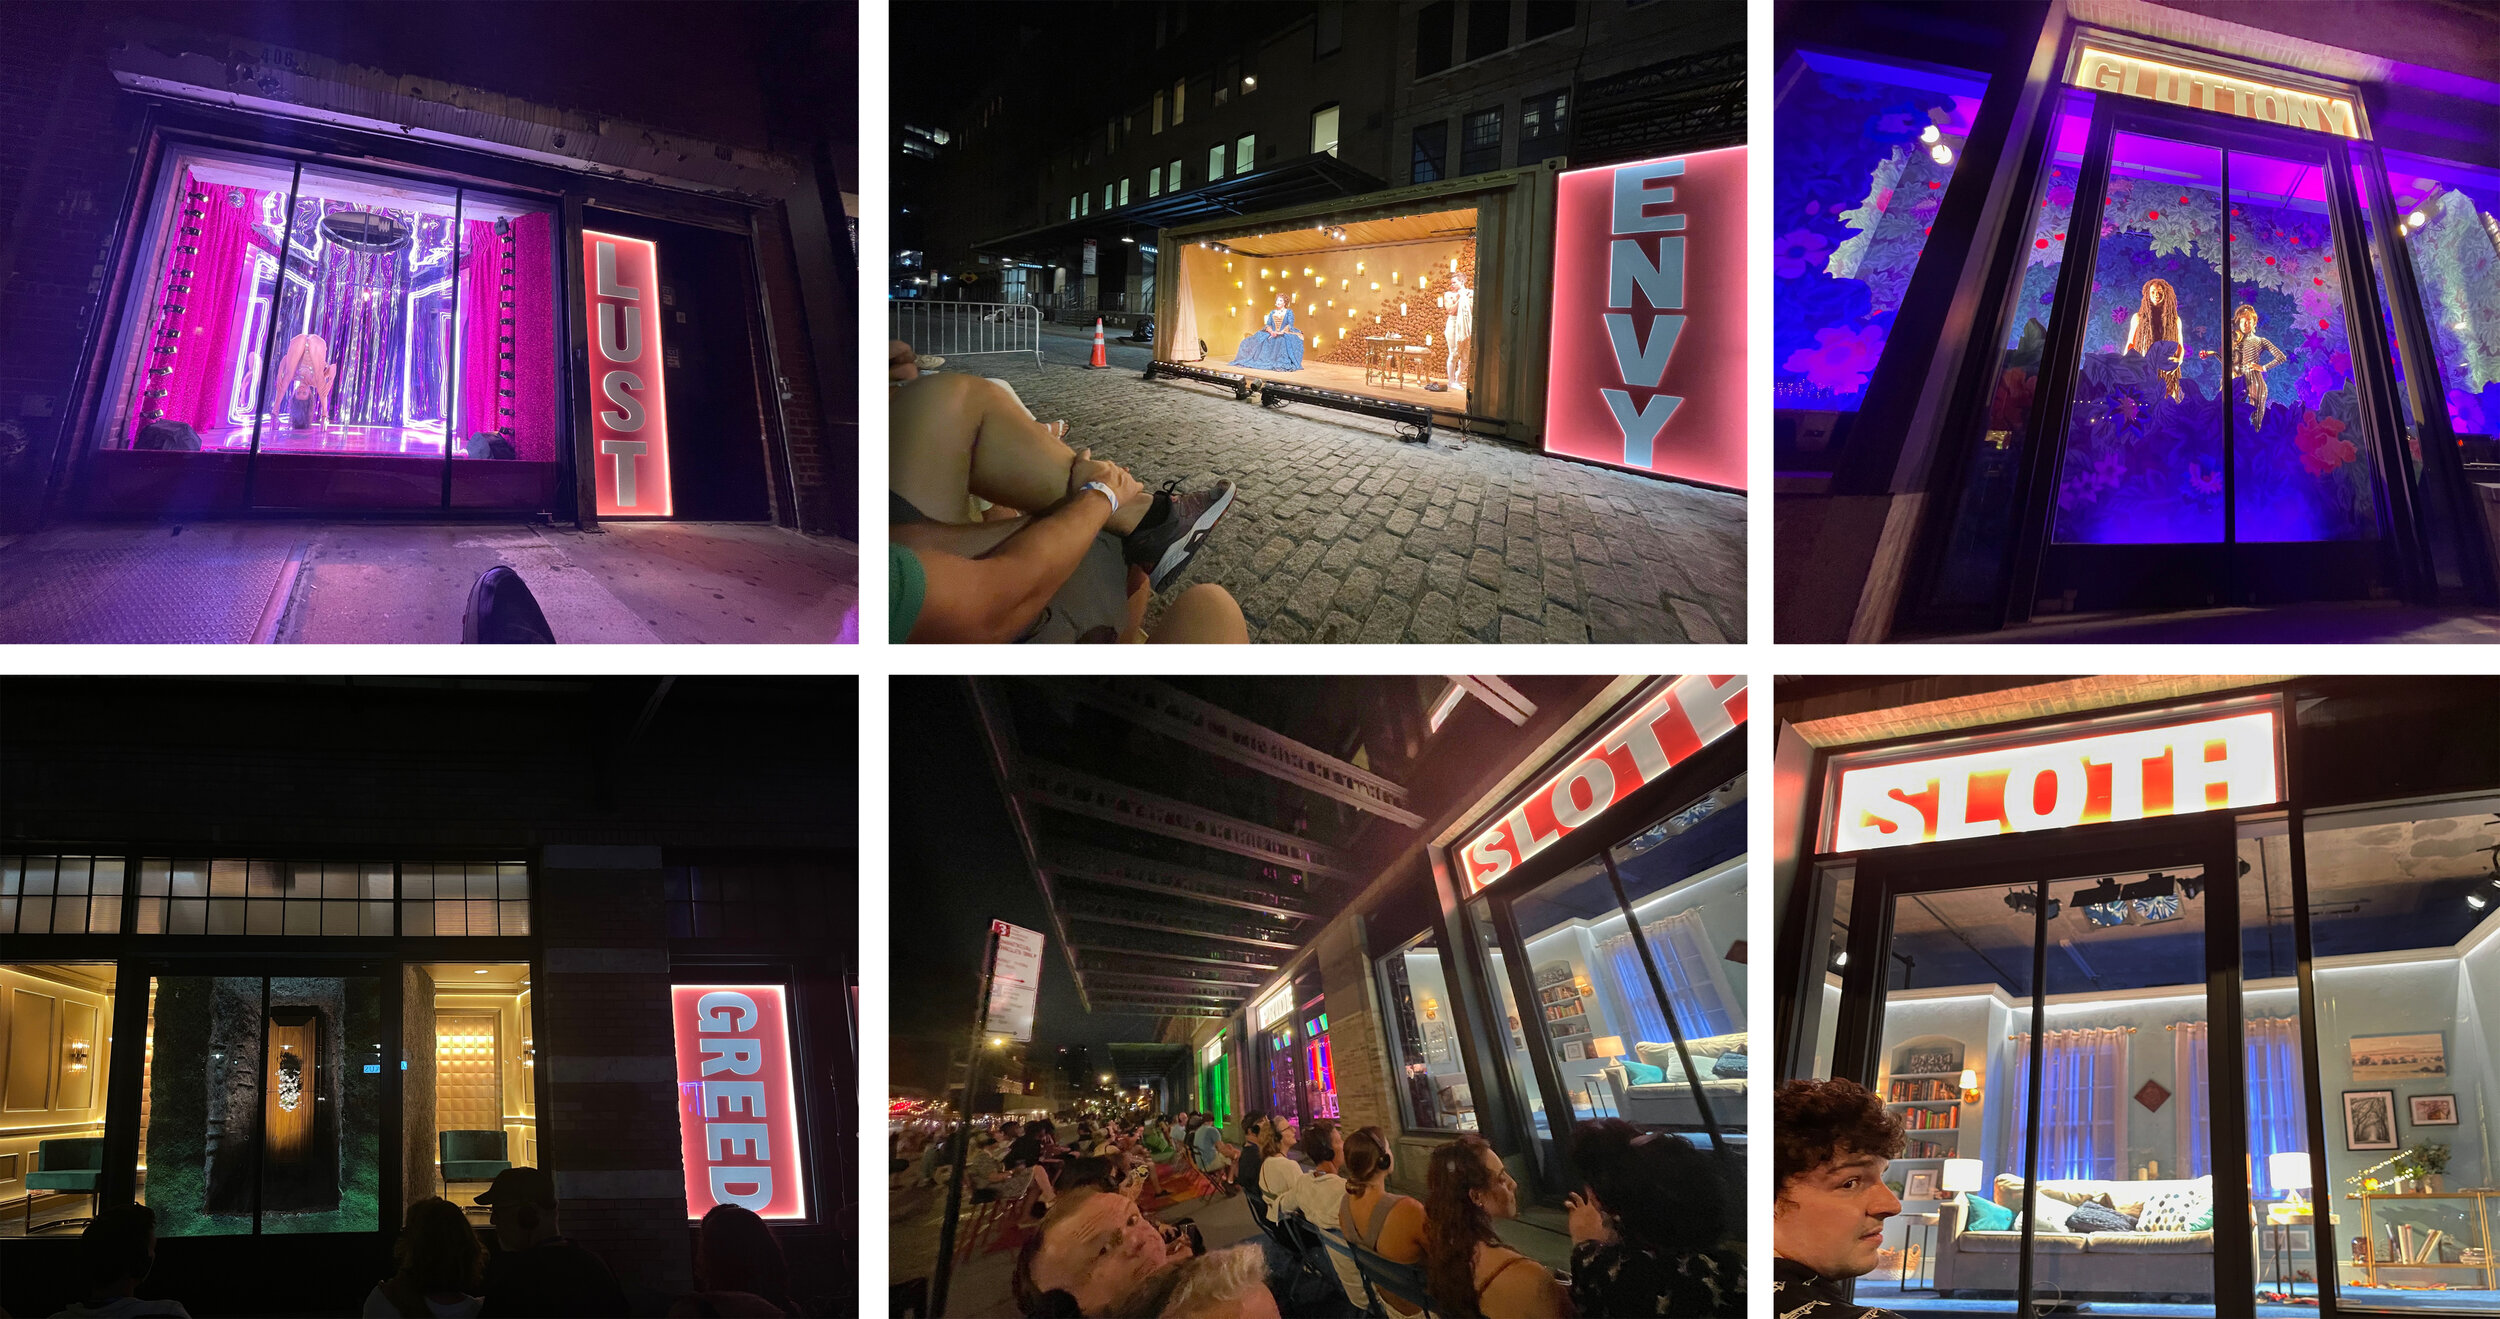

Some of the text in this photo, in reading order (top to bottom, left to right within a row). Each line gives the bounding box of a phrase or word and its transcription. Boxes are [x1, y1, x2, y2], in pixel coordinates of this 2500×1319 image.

[2095, 56, 2348, 135] GLUTTONY
[597, 241, 648, 507] LUST
[1600, 159, 1687, 468] ENVY
[1472, 675, 1748, 885] SLOTH
[1858, 724, 2262, 846] SLOTH
[697, 991, 773, 1212] GREED
